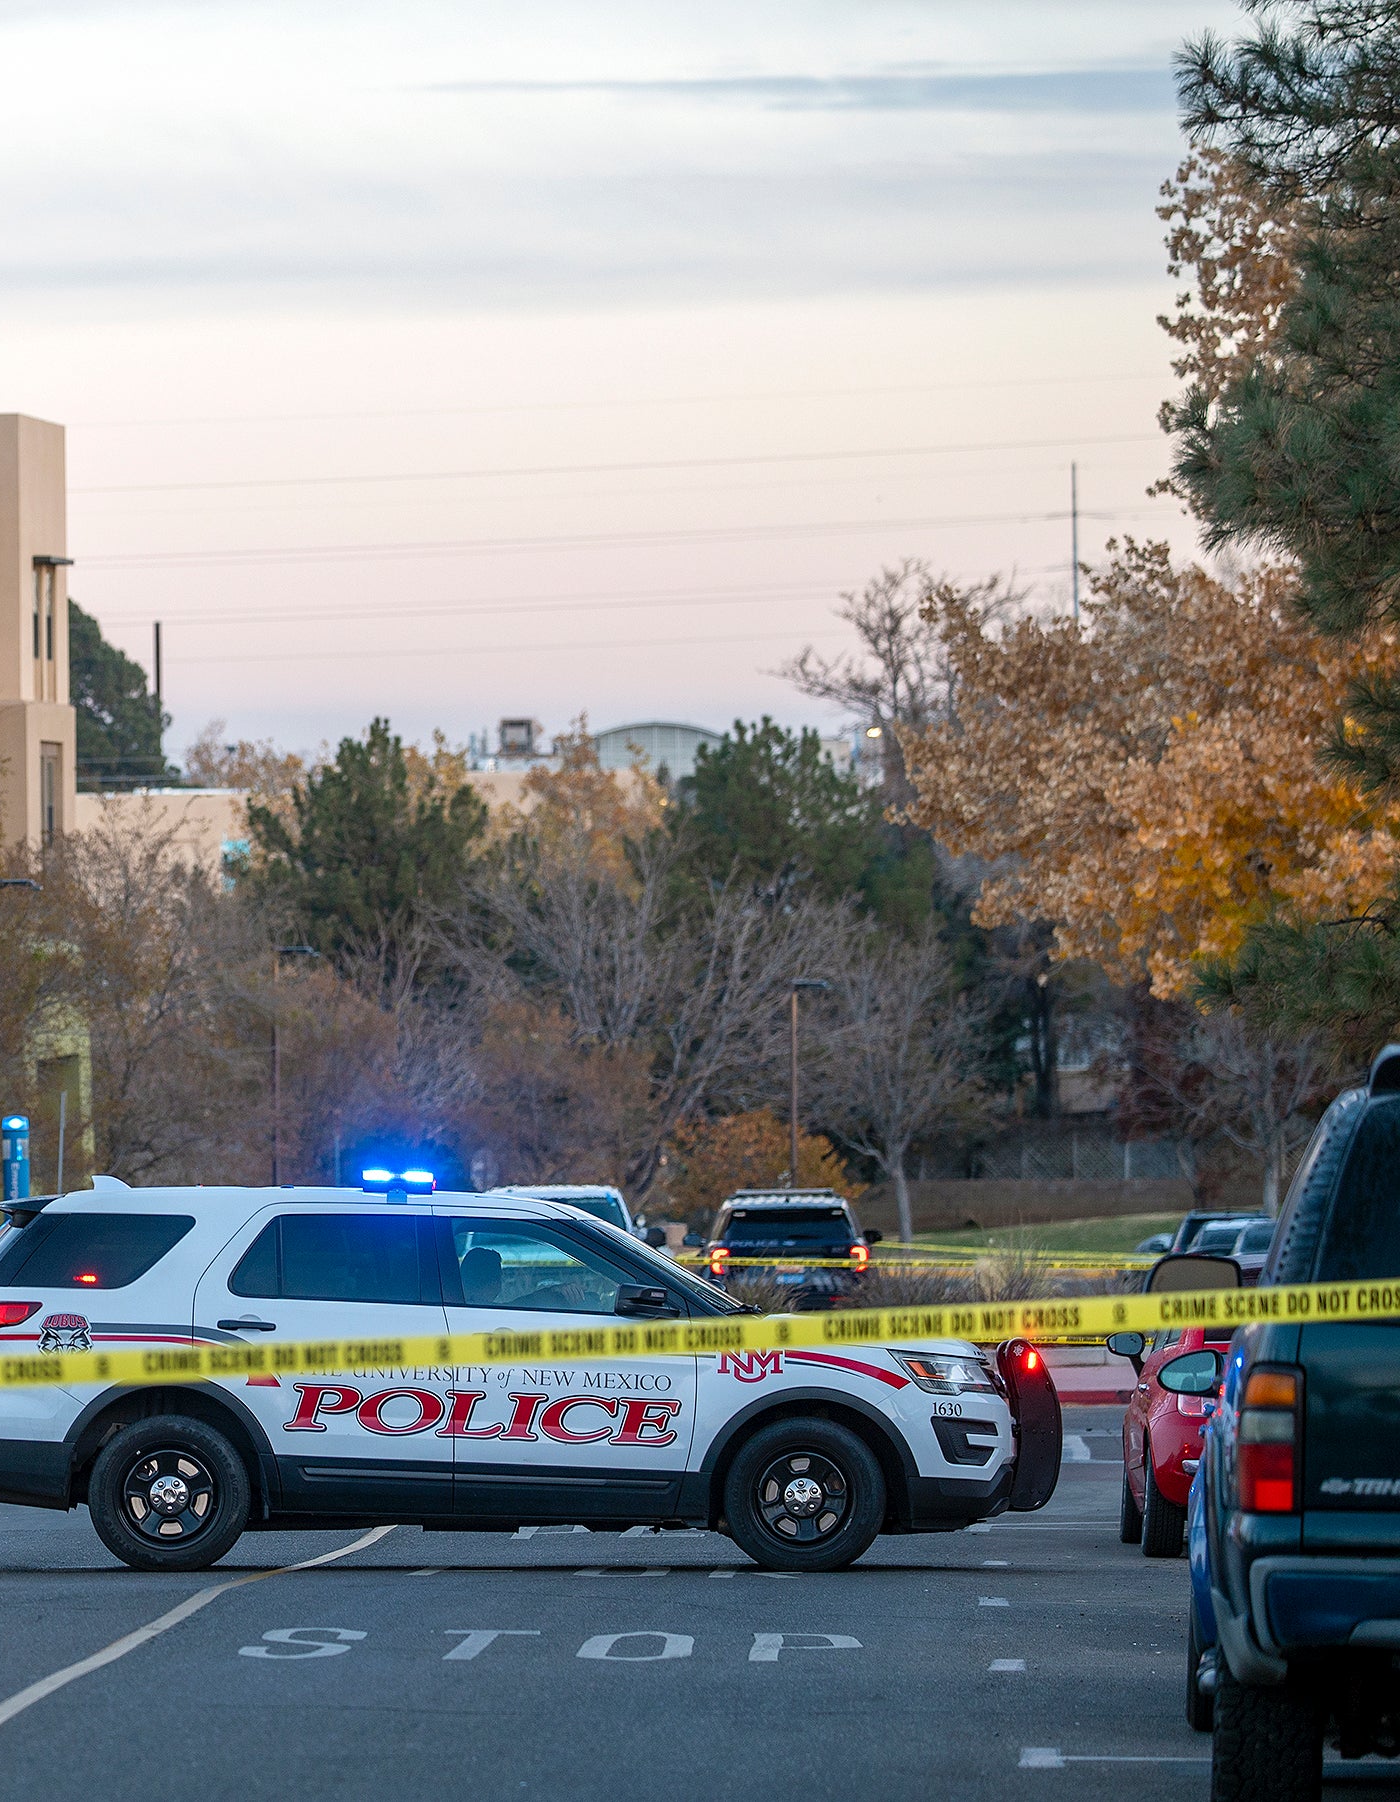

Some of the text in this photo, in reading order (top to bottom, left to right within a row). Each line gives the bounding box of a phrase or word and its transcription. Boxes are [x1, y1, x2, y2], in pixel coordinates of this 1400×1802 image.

[1160, 1298, 1216, 1321] CRIME
[1225, 1294, 1280, 1316] SCENE
[1288, 1293, 1309, 1314] DO
[1317, 1290, 1349, 1312] NOT
[43, 1313, 87, 1328] LOBOS
[823, 1305, 1080, 1340] CRIME SCENE DO NOT CROSS
[3, 1357, 63, 1380] CROSS
[352, 1364, 493, 1384] UNIVERSITY
[497, 1369, 516, 1388] of
[522, 1369, 575, 1387] NEW
[583, 1371, 672, 1392] MEXICO
[282, 1382, 682, 1446] POLICE
[932, 1402, 962, 1417] 1630
[237, 1625, 864, 1662] STOP
